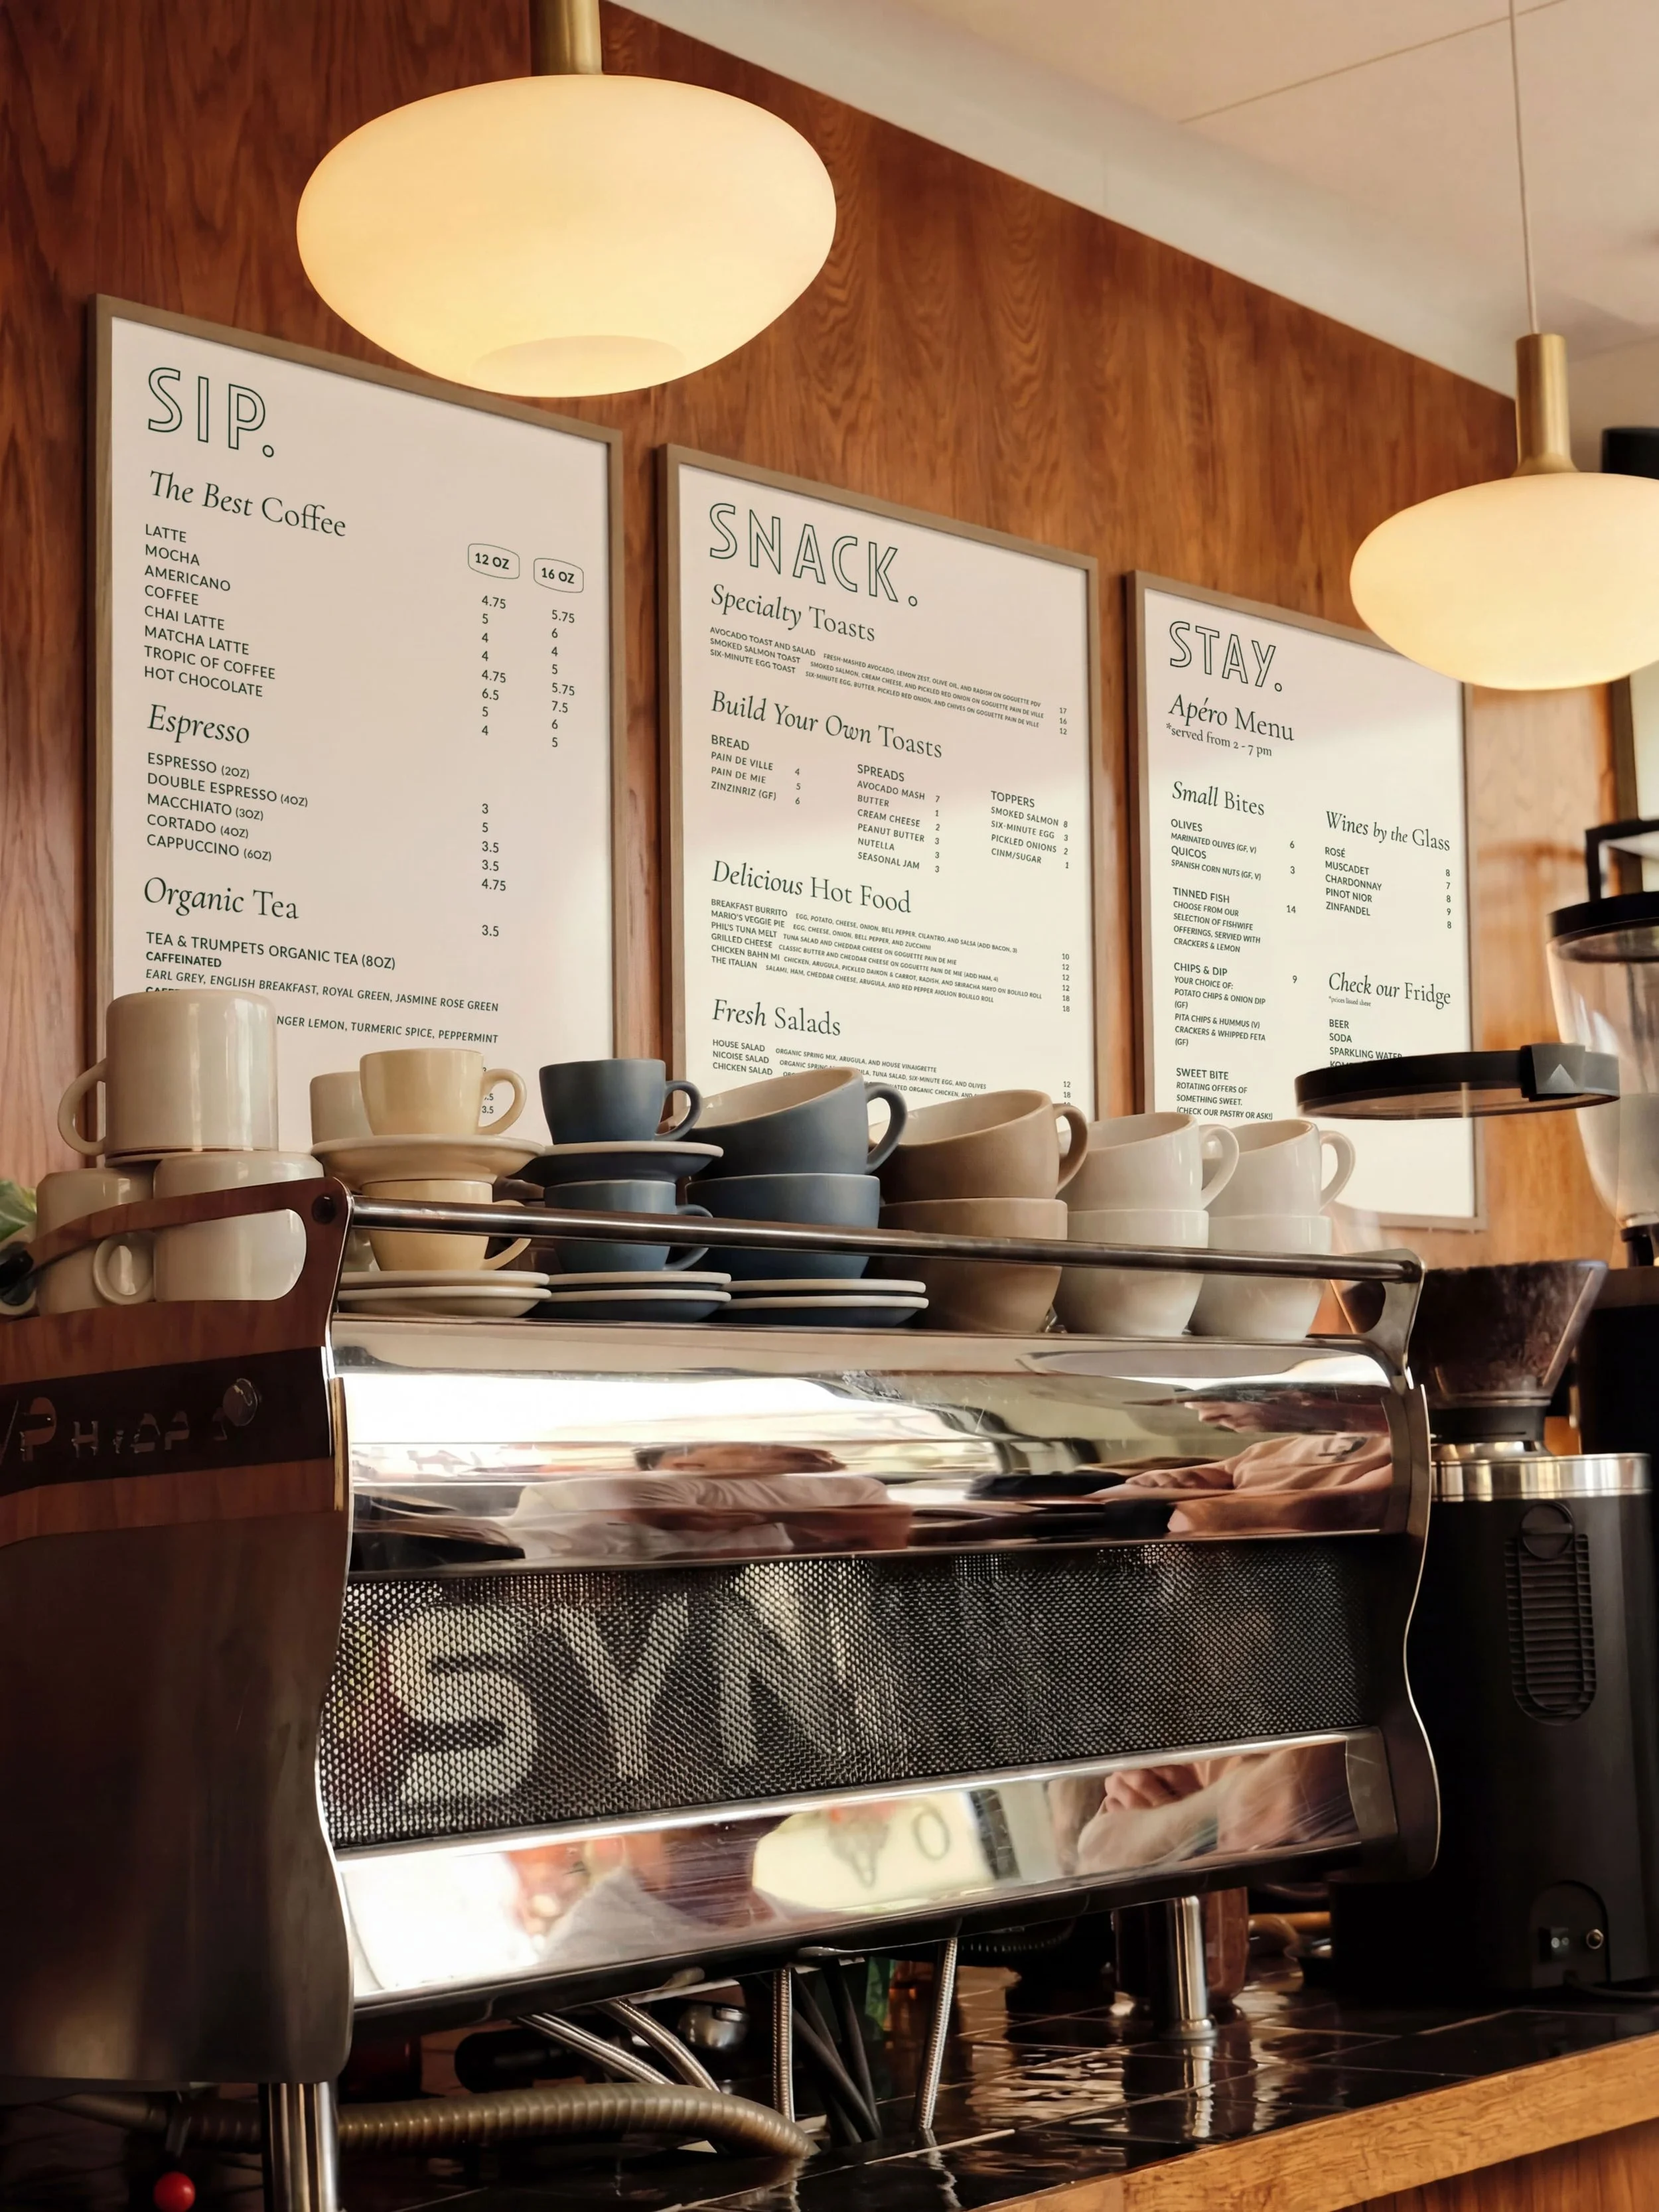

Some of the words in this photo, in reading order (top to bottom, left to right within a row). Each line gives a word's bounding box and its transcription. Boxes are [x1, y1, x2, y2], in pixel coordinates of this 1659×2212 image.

[147, 366, 274, 458] SIP.
[149, 469, 194, 504] The
[201, 482, 253, 516] Best
[261, 496, 346, 537] Coffee
[145, 523, 186, 543] LATTE
[145, 543, 200, 566] MOCHA
[474, 552, 489, 565] 12
[492, 556, 510, 570] OZ
[709, 502, 918, 607] SNACK.
[144, 564, 230, 591] AMERICANO
[541, 567, 555, 580] 16
[557, 571, 575, 585] OZ
[144, 584, 198, 606] COFFEE
[481, 594, 506, 609] 4.75
[144, 604, 179, 622] CHAI
[184, 612, 225, 631] LATTE
[551, 608, 575, 624] 5.75
[711, 583, 802, 631] Specialty
[808, 605, 875, 642] Toasts
[144, 624, 205, 648] MATCHA
[208, 636, 249, 656] LATTE
[709, 626, 748, 641] AVOCADO
[748, 634, 773, 646] TOAST
[773, 641, 791, 651] AND
[792, 644, 816, 656] SALAD
[709, 637, 743, 651] SMOKED
[744, 645, 776, 658] SALMON
[776, 652, 801, 663] TOAST
[143, 644, 196, 665] TROPIC
[200, 656, 220, 669] OF
[223, 659, 275, 679] COFFEE
[709, 648, 753, 665] SIX-MINUTE
[755, 658, 771, 668] EGG
[771, 661, 796, 674] TOAST
[1169, 620, 1283, 692] STAY.
[144, 665, 175, 682] HOT
[178, 671, 263, 697] CHOCOLATE
[823, 652, 867, 668] FRESH-MASHED
[896, 669, 916, 679] LEMON
[931, 677, 948, 687] OLIVE
[972, 687, 993, 697] RADISH
[1001, 693, 1029, 705] GOGUETTE
[147, 703, 250, 744] Espresso
[711, 689, 766, 722] Build
[773, 702, 819, 732] Your
[825, 715, 871, 744] Own
[877, 724, 942, 758] Toasts
[1167, 693, 1228, 726] Apéro
[1234, 707, 1295, 741] Menu
[711, 734, 749, 751] BREAD
[1206, 730, 1230, 748] from
[1232, 740, 1239, 749] 2
[1247, 744, 1254, 756] 7
[1256, 746, 1272, 758] pm
[147, 751, 217, 774] ESPRESSO
[221, 764, 250, 780] (2OZ)
[857, 763, 904, 782] SPREADS
[147, 772, 205, 792] DOUBLE
[210, 781, 277, 802] ESPRESSO
[280, 794, 308, 807] (4OZ)
[710, 780, 757, 797] ZINZINRIZ
[758, 789, 776, 801] (GF)
[856, 780, 899, 795] AVOCADO
[901, 788, 925, 800] MASH
[990, 790, 1035, 808] TOPPERS
[1171, 780, 1218, 807] Small
[1224, 790, 1264, 815] Bites
[147, 792, 232, 815] MACCHIATO
[235, 807, 263, 821] (3OZ)
[857, 808, 887, 821] CREAM
[889, 814, 920, 827] CHEESE
[990, 805, 1024, 819] SMOKED
[1025, 813, 1058, 826] SALMON
[147, 813, 216, 833] CORTADO
[220, 825, 249, 839] (4OZ)
[857, 822, 891, 836] PEANUT
[893, 829, 924, 843] BUTTER
[1170, 818, 1202, 833] OLIVES
[1325, 810, 1369, 835] Wines
[1373, 821, 1387, 843] by
[1390, 825, 1408, 843] the
[1411, 828, 1450, 851] Glass
[146, 833, 240, 857] CAPPUCCINO
[243, 847, 271, 862] (6OZ)
[991, 833, 1024, 847] PICKLED
[1025, 840, 1056, 853] ONIONS
[991, 847, 1042, 864] CINM/SUGAR
[1171, 859, 1200, 870] SPANISH
[1200, 863, 1221, 874] CORN
[1222, 867, 1240, 877] NUTS
[711, 860, 803, 896] Delicious
[810, 876, 853, 904] Hot
[859, 884, 911, 913] Food
[1172, 886, 1208, 900] TINNED
[1210, 892, 1230, 904] FISH
[1325, 873, 1382, 891] CHARDONNAY
[144, 876, 244, 916] Organic
[252, 889, 299, 920] Tea
[711, 898, 754, 912] BREAKFAST
[755, 905, 788, 917] BURRITO
[711, 909, 743, 922] MARIO'S
[744, 914, 772, 926] VEGGIE
[773, 919, 785, 928] PIE
[145, 931, 173, 946] TEA
[177, 934, 187, 947] &
[190, 935, 264, 955] TRUMPETS
[268, 944, 330, 963] ORGANIC
[333, 951, 358, 965] TEA
[361, 953, 396, 971] (8OZ)
[1242, 934, 1261, 943] WITH
[145, 951, 222, 967] CAFFEINATED
[1173, 961, 1201, 974] CHIPS
[1202, 965, 1210, 975] &
[1212, 966, 1228, 977] DIP
[145, 968, 173, 981] EARL
[175, 971, 206, 985] GREY,
[210, 975, 255, 989] ENGLISH
[258, 979, 319, 996] BREAKFAST,
[322, 985, 354, 998] ROYAL
[356, 989, 392, 1003] GREEN,
[395, 993, 437, 1006] JASMINE
[439, 997, 465, 1008] ROSE
[467, 1000, 498, 1012] GREEN
[1328, 971, 1372, 995] Check
[1376, 984, 1400, 998] our
[1404, 981, 1451, 1010] Fridge
[711, 998, 766, 1026] Fresh
[774, 1006, 841, 1036] Salads
[1329, 1018, 1349, 1029] BEER
[1174, 1025, 1210, 1036] CRACKERS
[1217, 1029, 1249, 1040] WHIPPED
[1250, 1032, 1265, 1041] FETA
[712, 1050, 743, 1061] NICOISE
[745, 1054, 769, 1064] SALAD
[1175, 1067, 1207, 1078] SWEET
[1208, 1070, 1229, 1080] BITE
